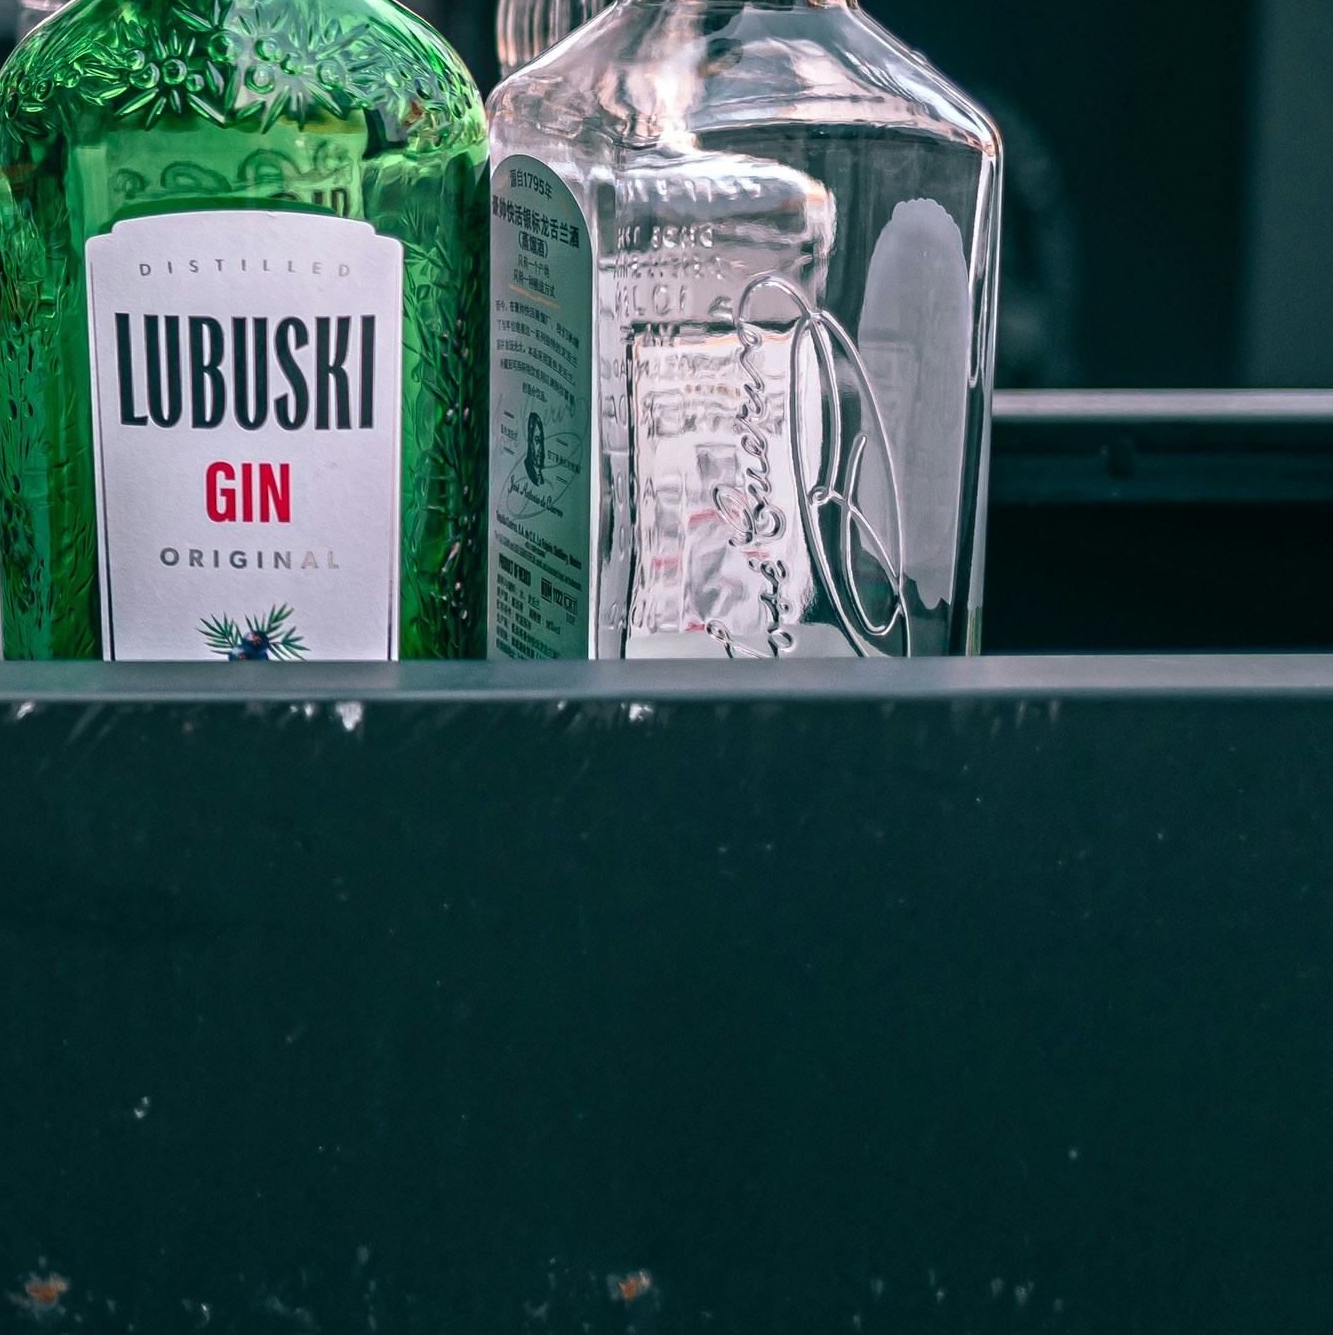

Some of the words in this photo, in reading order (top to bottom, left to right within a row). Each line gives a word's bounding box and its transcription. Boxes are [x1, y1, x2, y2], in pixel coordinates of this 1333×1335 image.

[140, 258, 351, 278] DISTILLED
[113, 311, 377, 431] LUBUSKI
[205, 461, 291, 524] GIN
[159, 546, 341, 570] ORIGINAL
